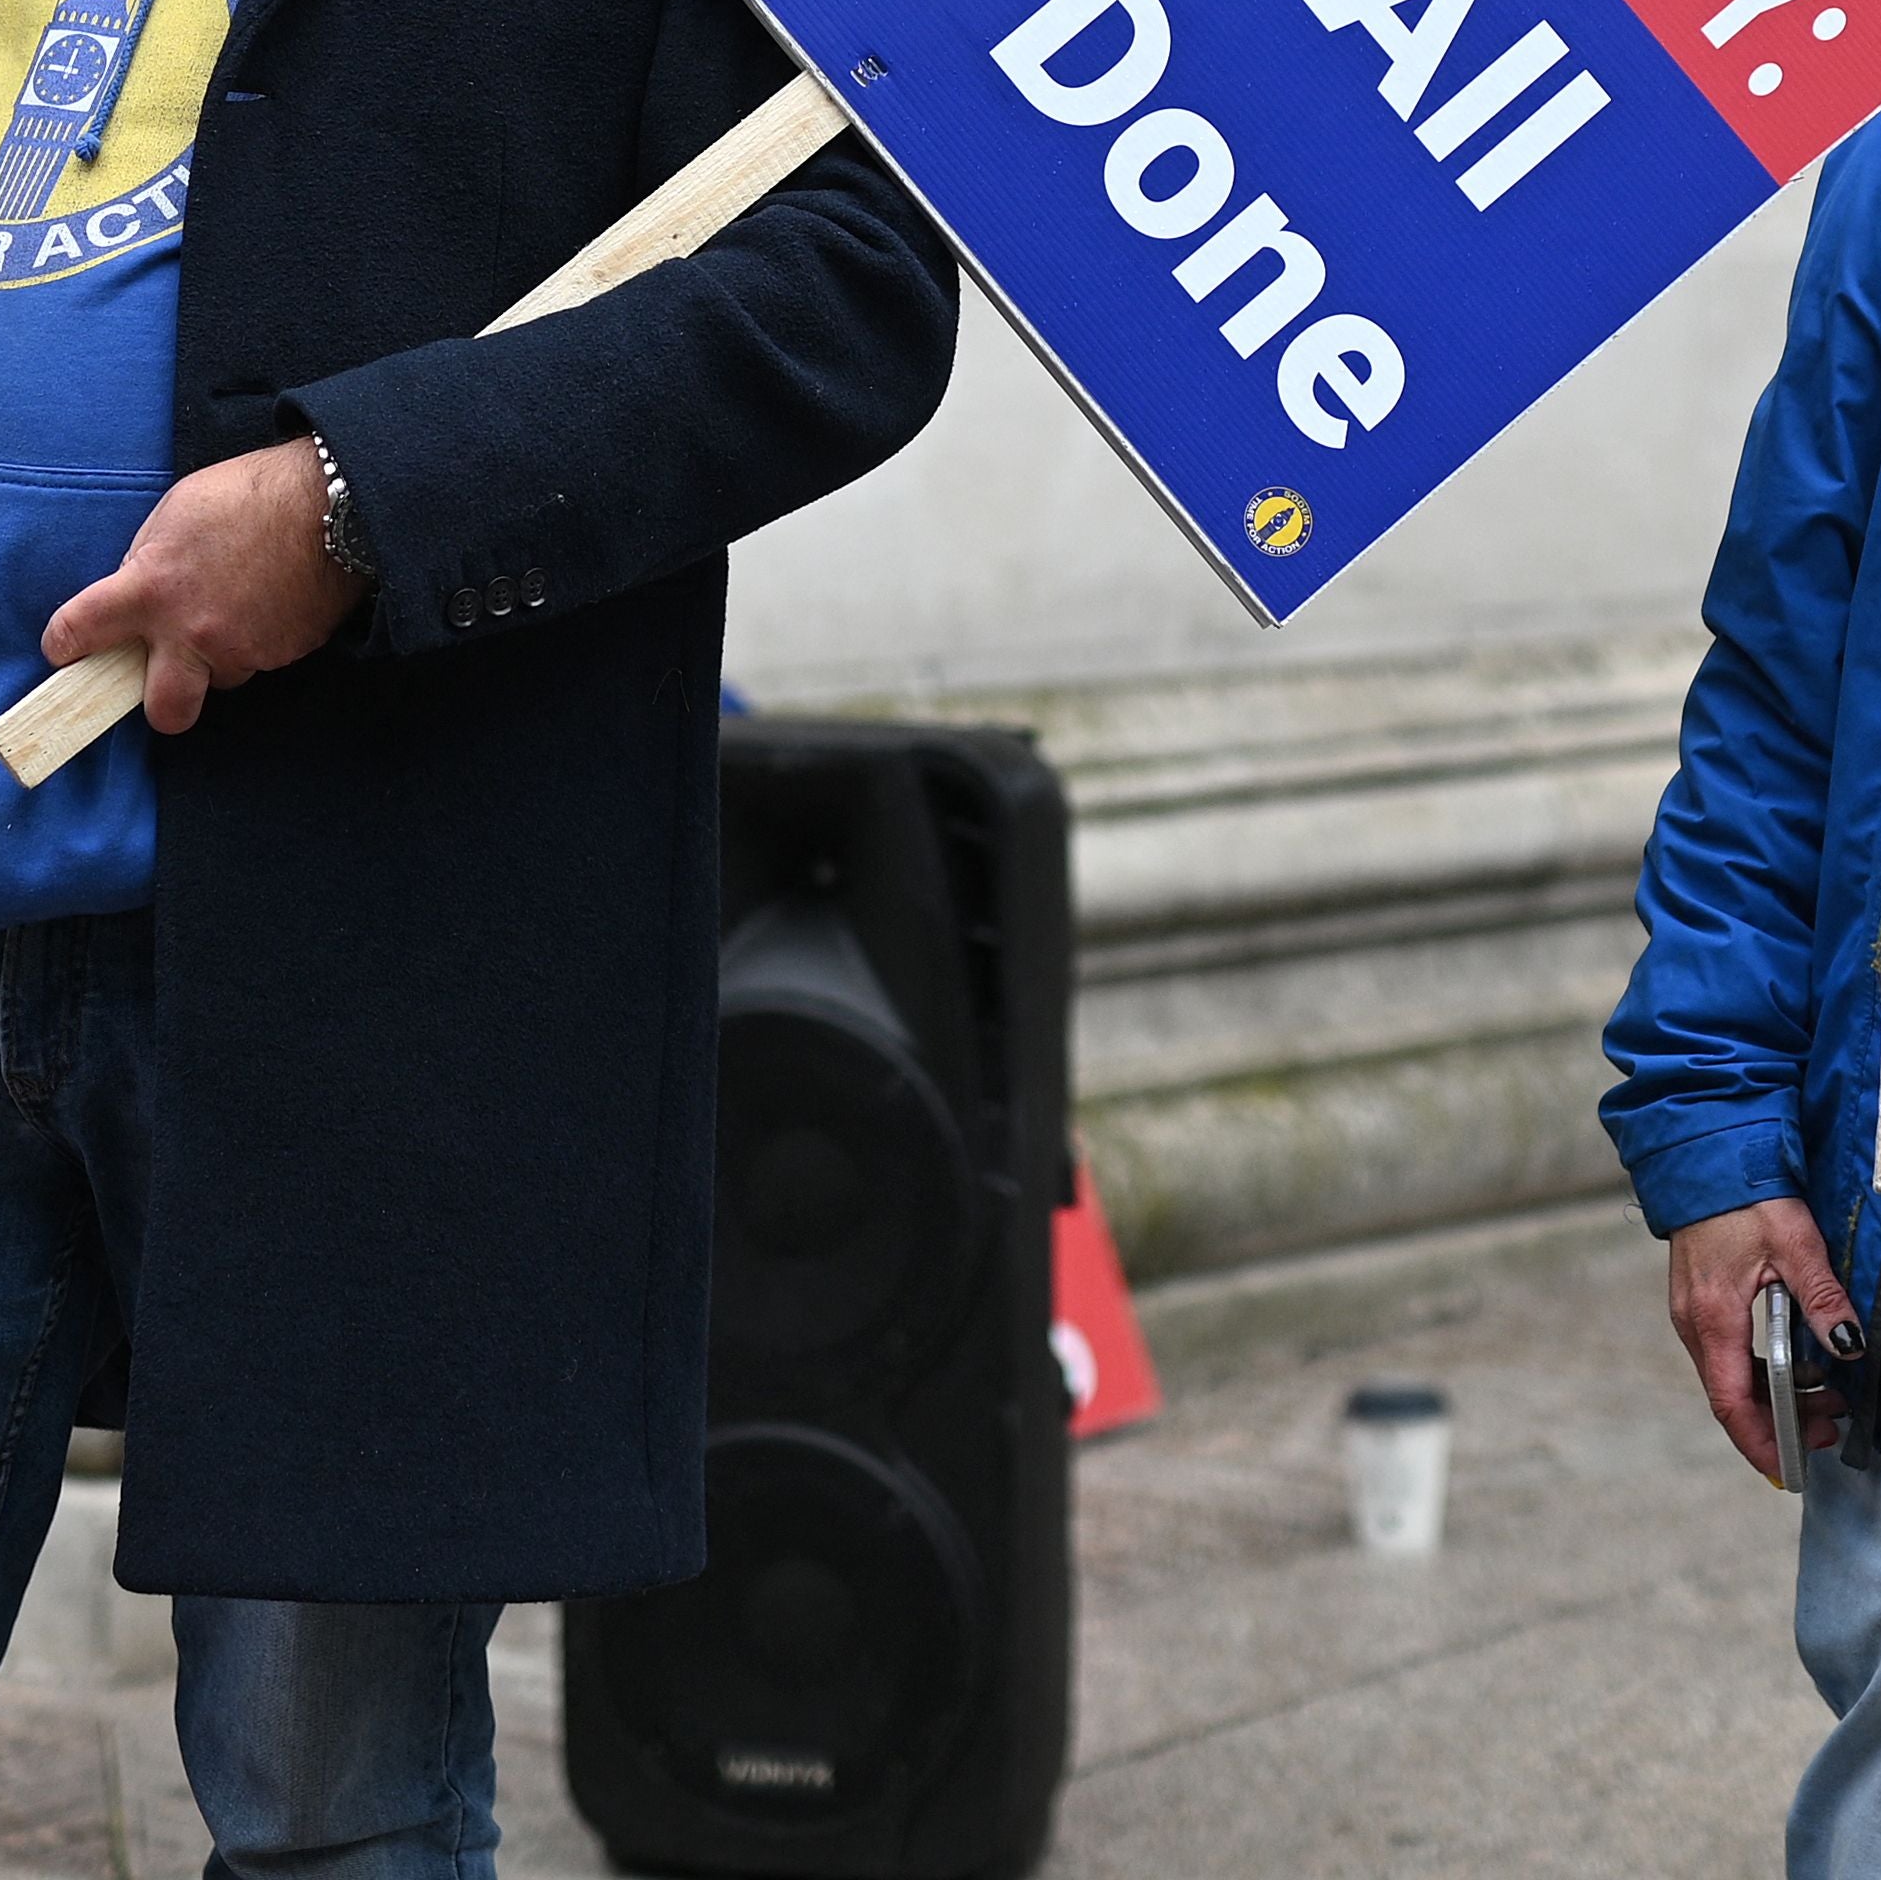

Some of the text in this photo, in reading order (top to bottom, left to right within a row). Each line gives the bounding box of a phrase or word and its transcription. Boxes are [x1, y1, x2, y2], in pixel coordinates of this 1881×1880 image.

[1246, 496, 1301, 555] TIME FOR ACTION
